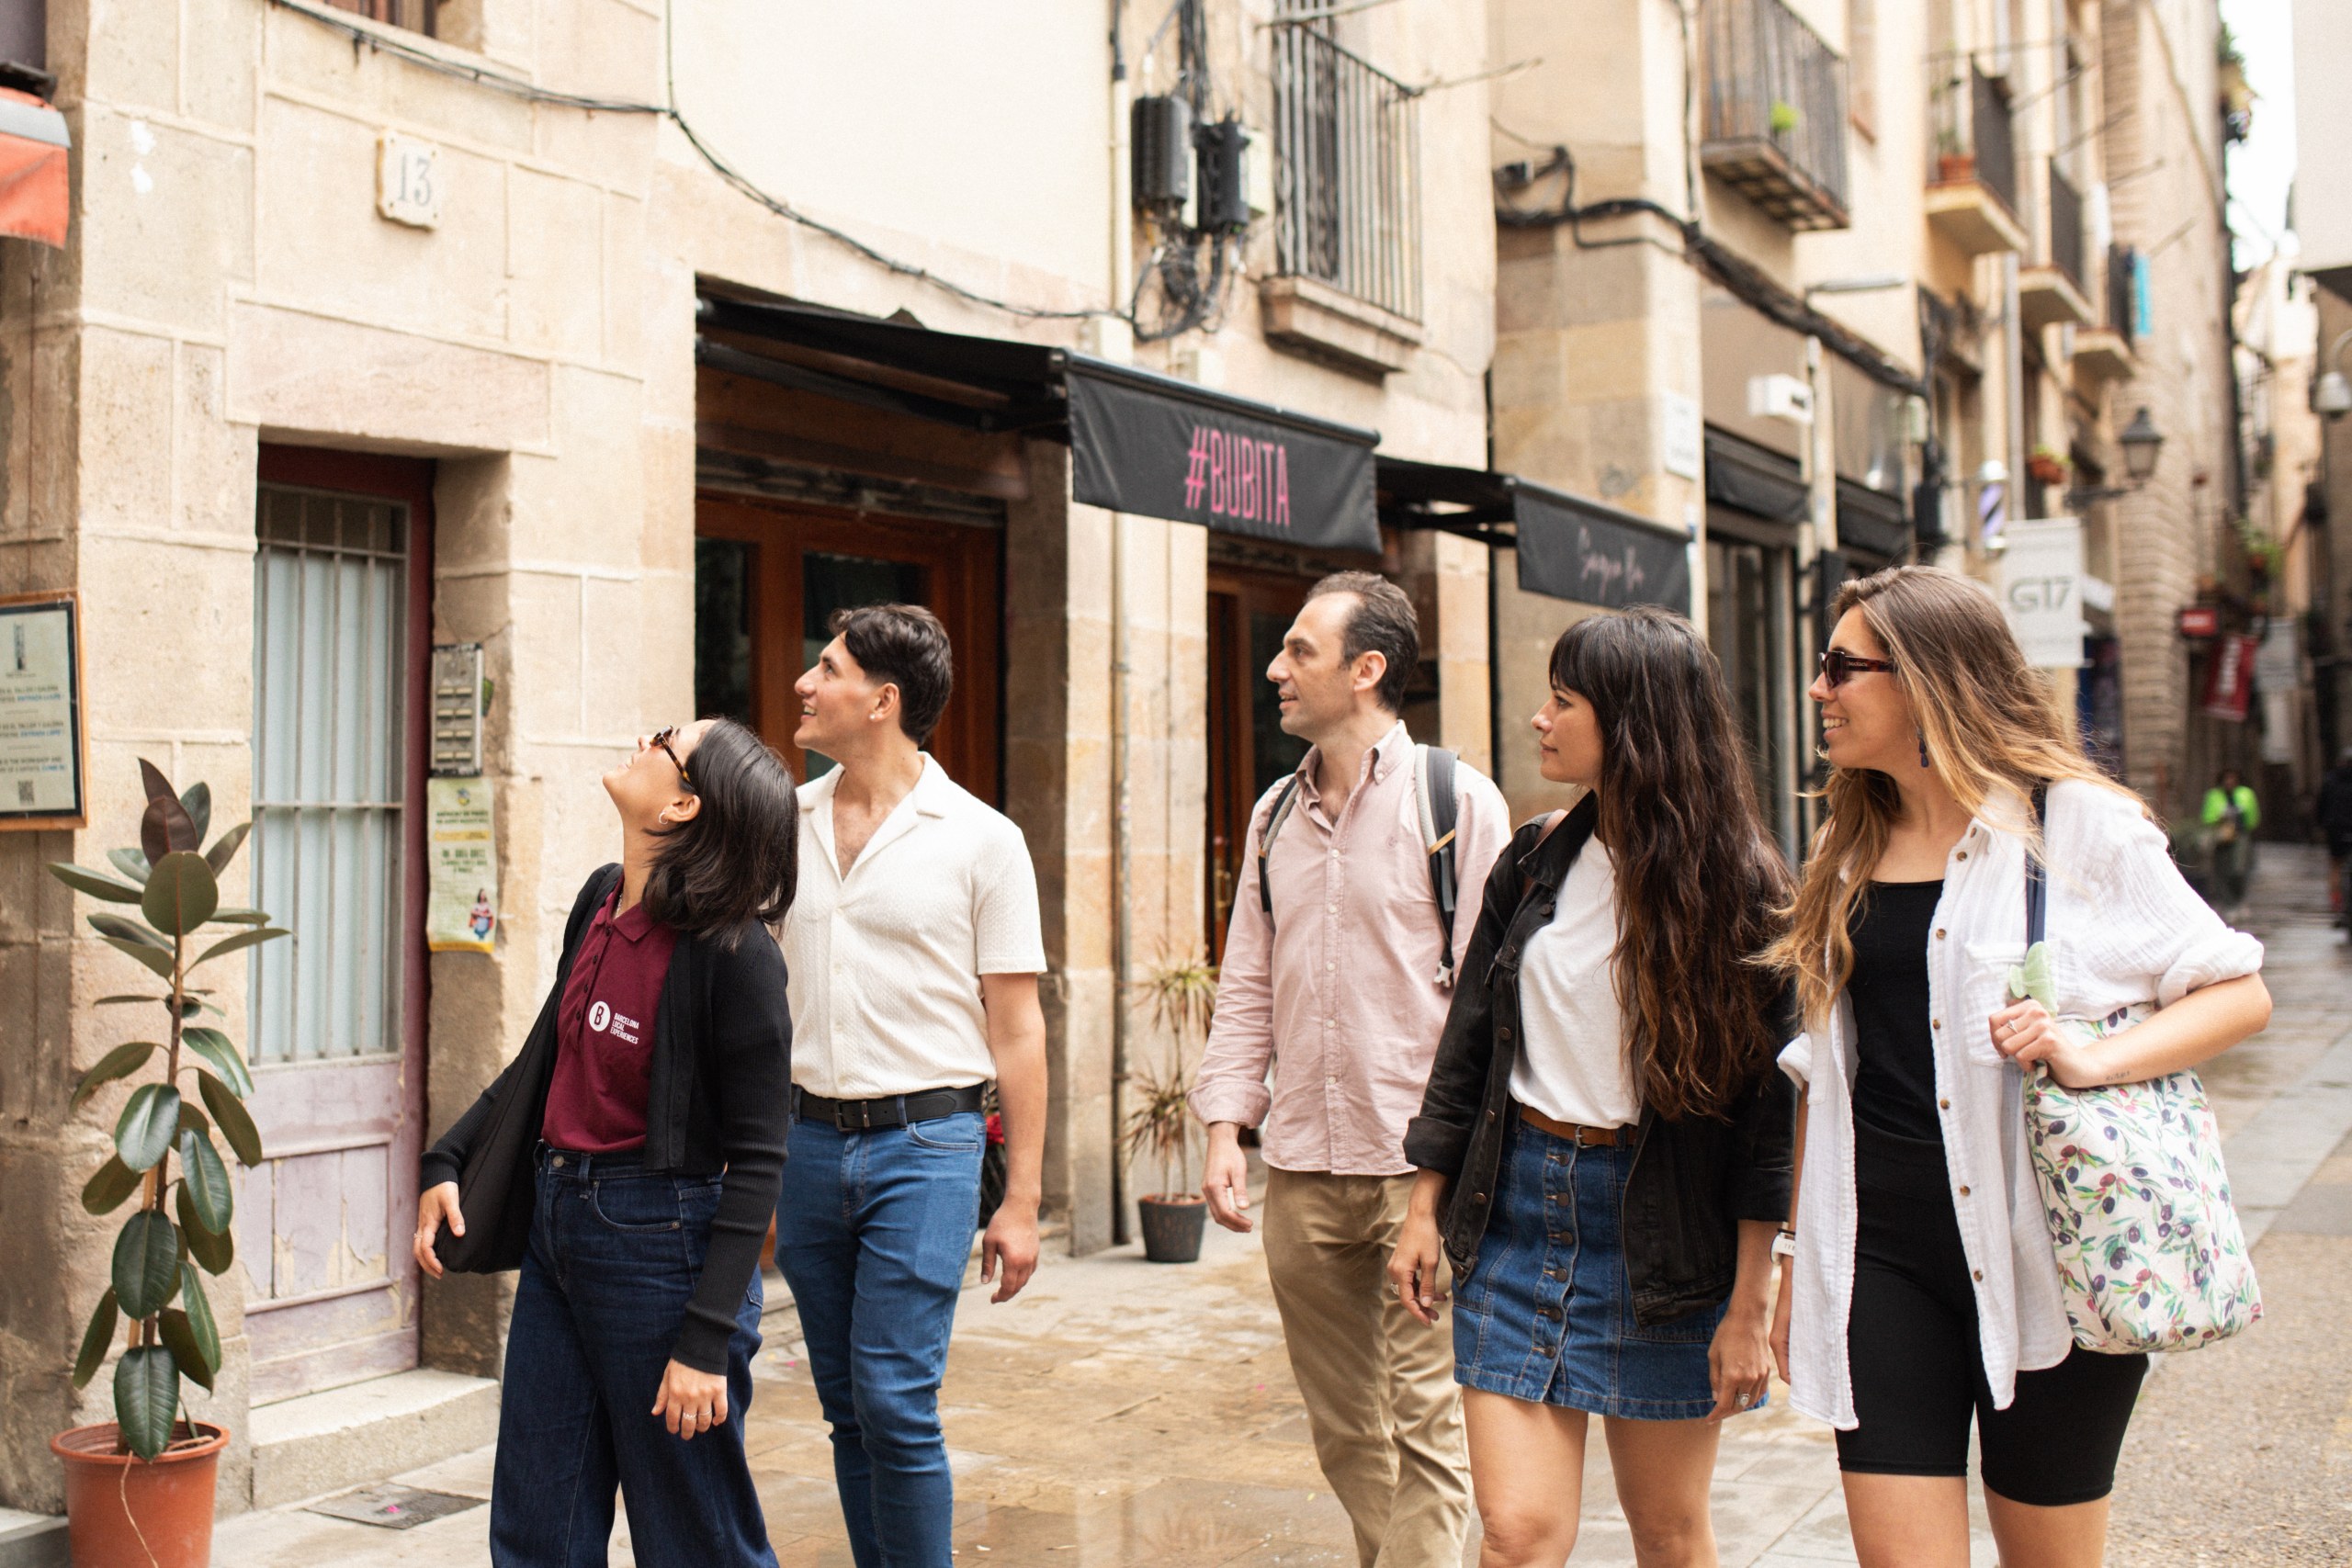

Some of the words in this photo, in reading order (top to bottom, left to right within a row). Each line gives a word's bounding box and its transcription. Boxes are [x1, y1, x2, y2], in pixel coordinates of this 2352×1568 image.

[397, 152, 432, 207] 13
[1184, 425, 1290, 526] #BUBITA
[2007, 575, 2073, 613] G17
[594, 1005, 605, 1026] B
[612, 1020, 625, 1032] LOCAL
[614, 1012, 639, 1030] BARCELONA
[610, 1026, 639, 1044] EXPERIENCES
